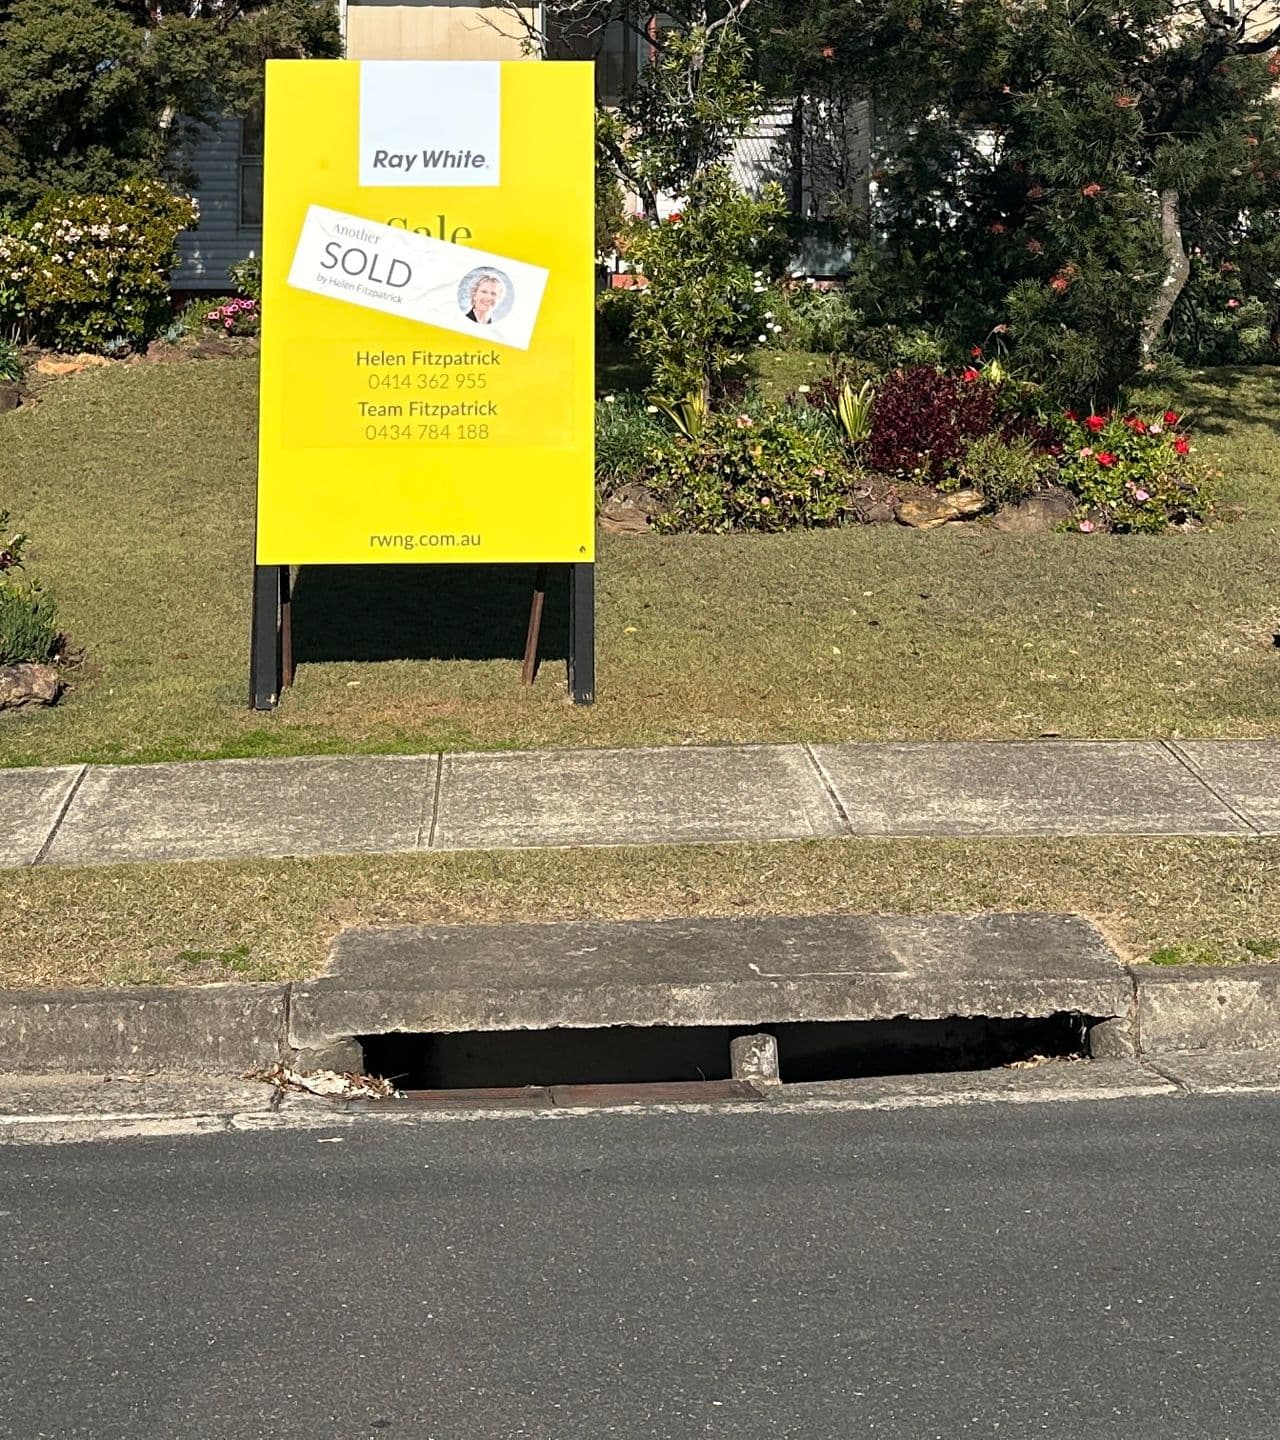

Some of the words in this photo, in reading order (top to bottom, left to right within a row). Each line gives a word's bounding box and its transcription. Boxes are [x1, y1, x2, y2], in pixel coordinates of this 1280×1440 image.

[372, 150, 418, 171] Ray
[333, 223, 382, 245] Another
[320, 241, 413, 288] SOLD
[316, 273, 328, 285] by
[329, 276, 355, 291] Helen
[356, 284, 403, 304] Fitzpatrick
[356, 351, 406, 367] Helen
[411, 350, 501, 369] Fitzpatrick
[367, 374, 412, 390] 0414
[417, 373, 449, 390] 362
[455, 373, 487, 390] 955
[358, 401, 403, 418] Team
[408, 400, 497, 420] Fitzpatrick
[365, 425, 412, 441] 0434
[417, 424, 450, 441] 784
[456, 424, 489, 440] 188
[369, 533, 481, 550] rwng.com.au
